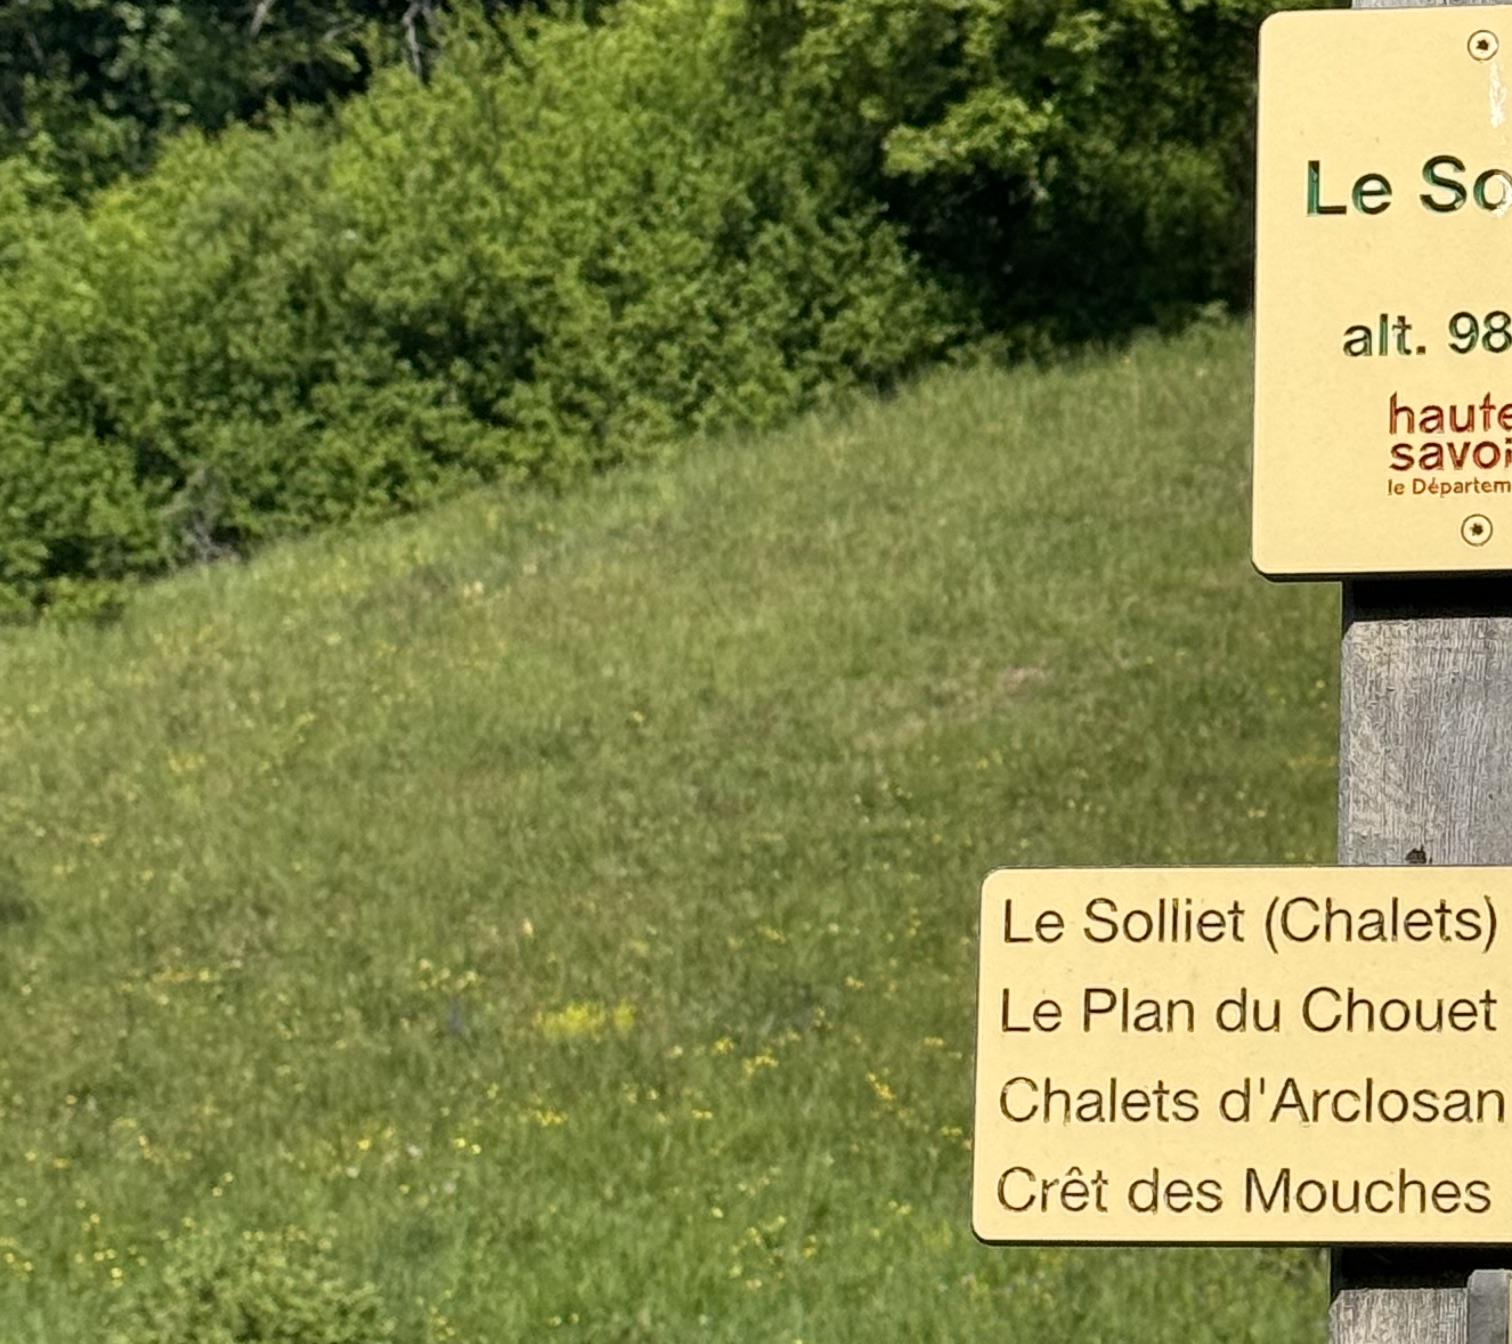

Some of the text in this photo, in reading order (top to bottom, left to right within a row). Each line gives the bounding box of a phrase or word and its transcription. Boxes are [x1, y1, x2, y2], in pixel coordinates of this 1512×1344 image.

[1306, 159, 1393, 217] Le
[1342, 313, 1427, 357] alt.
[1387, 477, 1406, 496] le
[1002, 894, 1499, 954] Le Solliet (Chalets)
[1001, 986, 1499, 1034] Le Plan du Chouet
[999, 1076, 1507, 1124] Chalets d'Arclosan
[997, 1164, 1493, 1215] Crêt des Mouches
